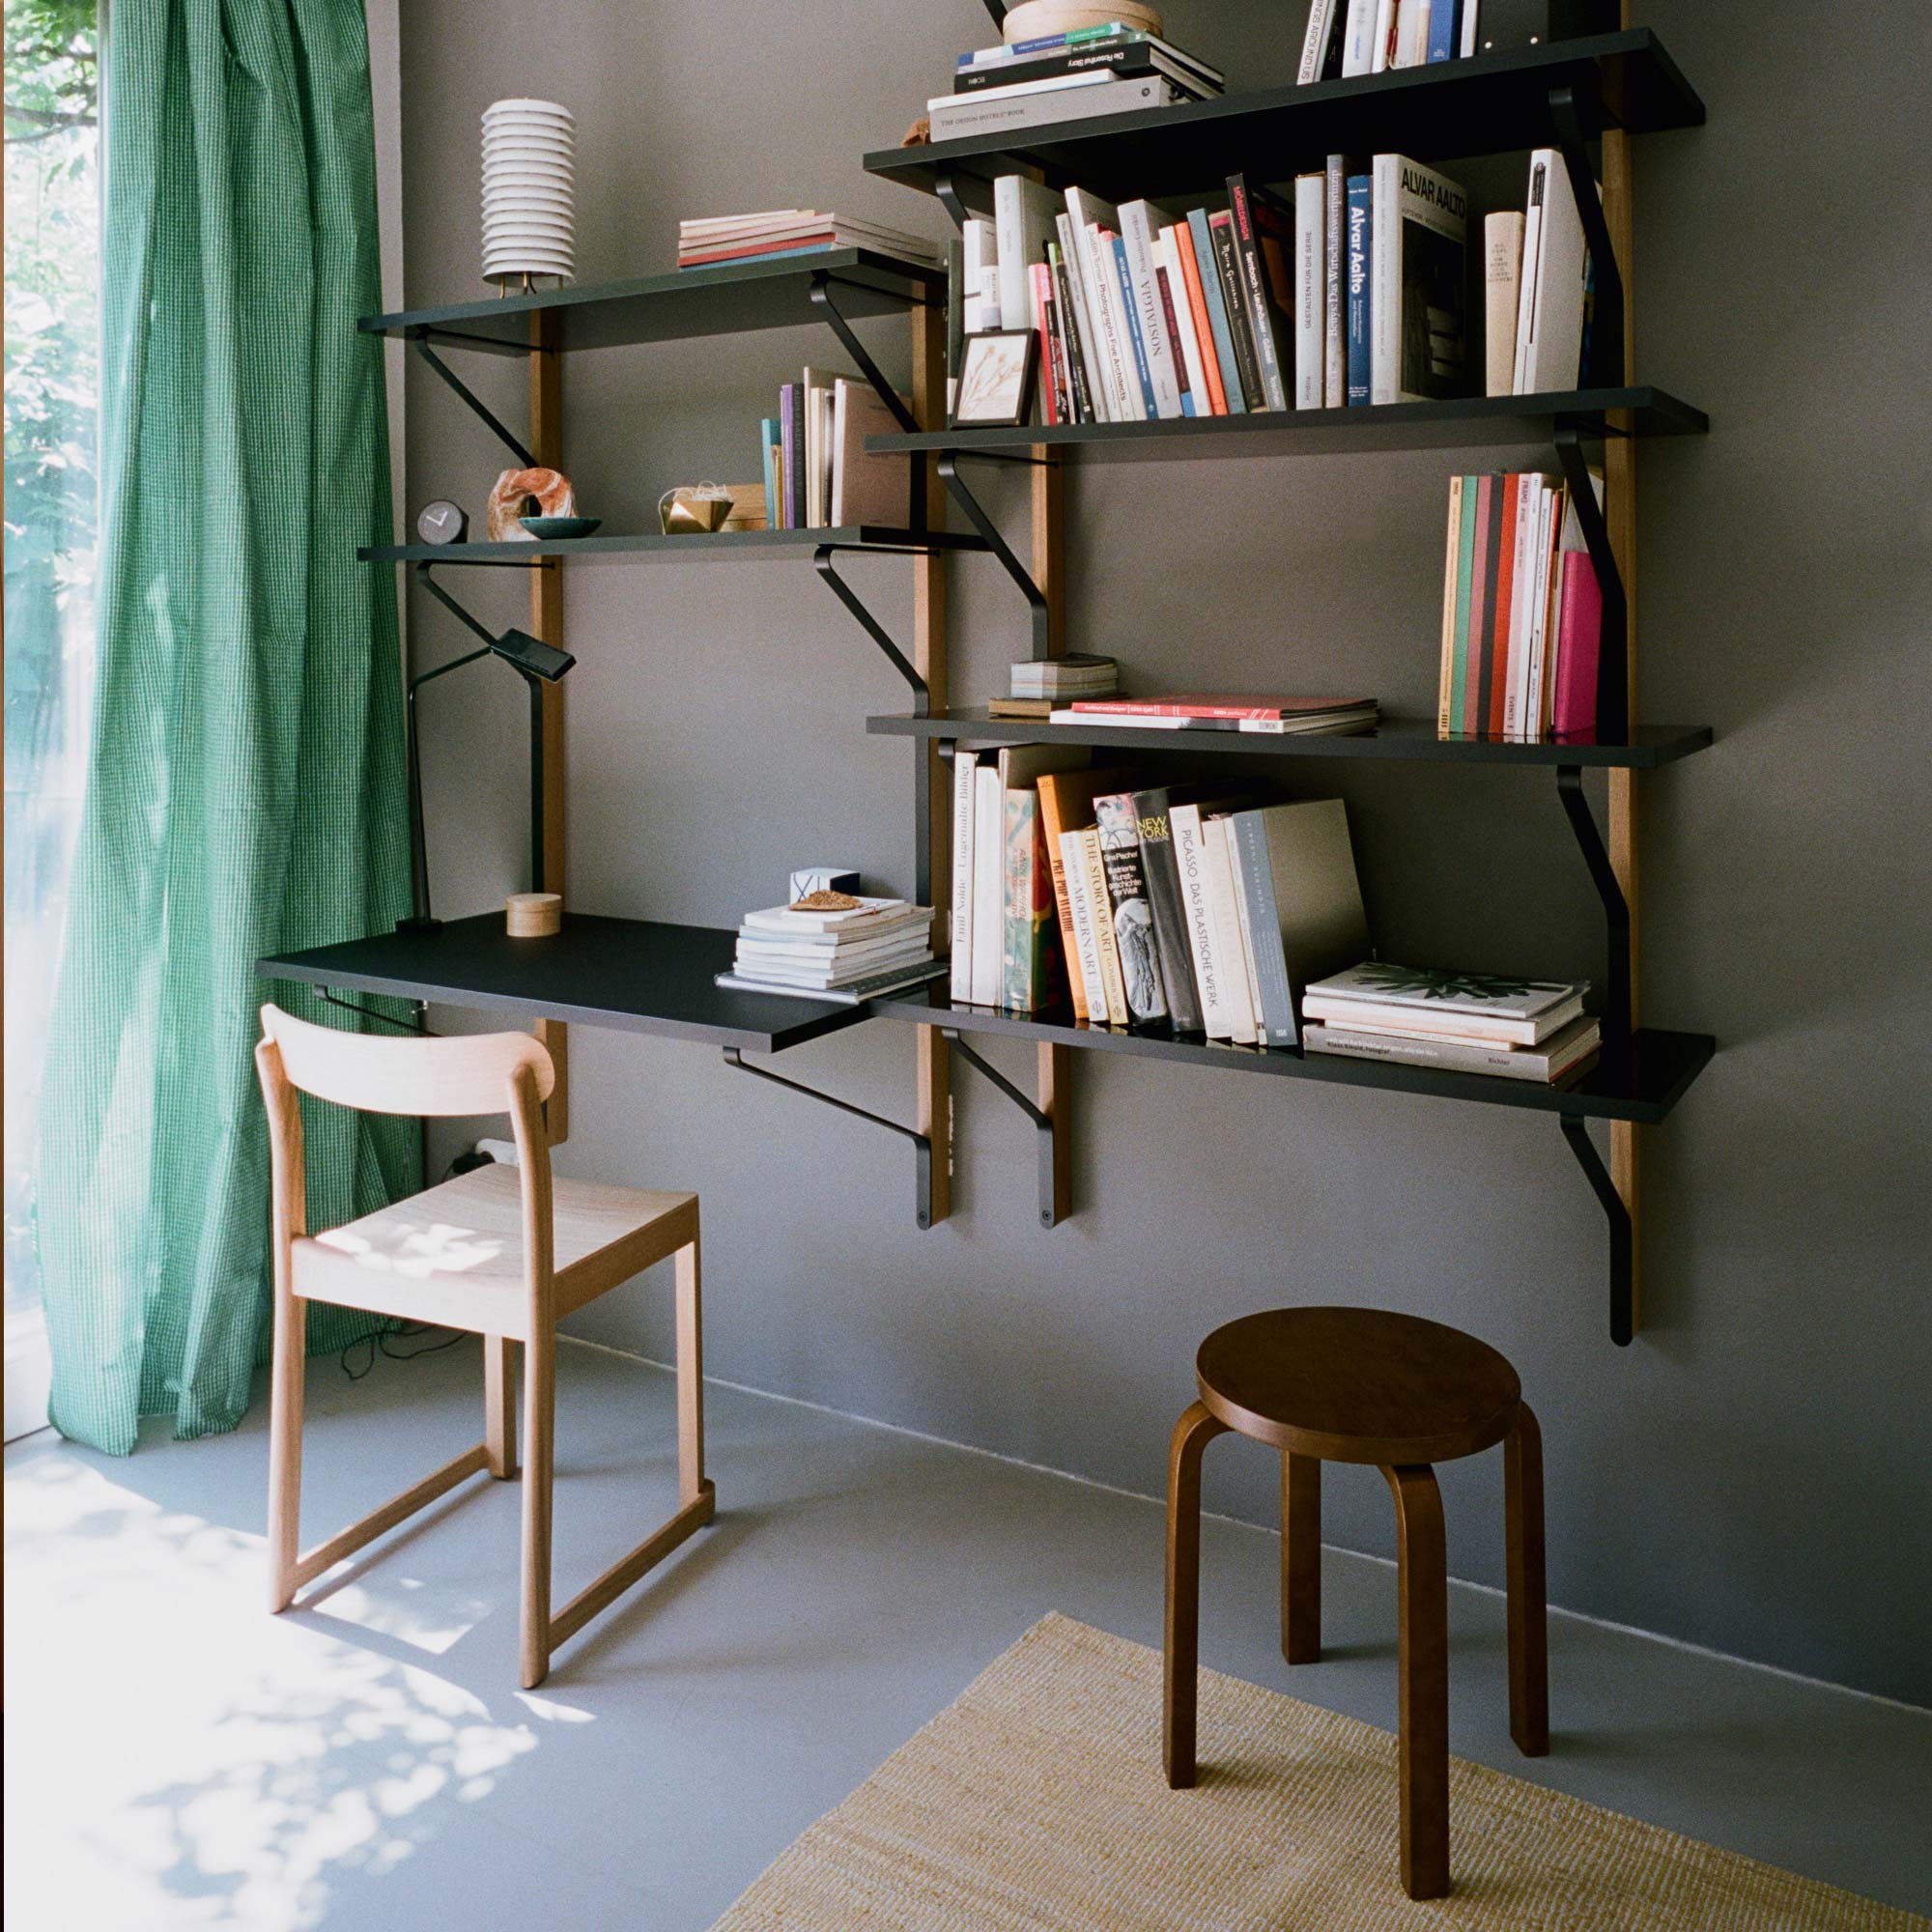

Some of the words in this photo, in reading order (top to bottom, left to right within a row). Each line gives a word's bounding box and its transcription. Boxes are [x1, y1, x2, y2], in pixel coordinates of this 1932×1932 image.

[1084, 53, 1112, 66] Rosenthal
[1113, 51, 1124, 62] Die
[1305, 25, 1320, 66] AROUND
[1066, 56, 1084, 68] Story
[1301, 66, 1311, 79] US
[1402, 167, 1435, 204] ALVAR
[1435, 185, 1465, 220] AALTO
[1350, 207, 1365, 249] Alvar
[1350, 252, 1365, 294] Aalto
[1233, 185, 1250, 240] MÖBELDESIGN
[1245, 251, 1259, 288] Sembach
[1268, 375, 1281, 407] Taschen
[1328, 282, 1341, 302] Das
[1098, 284, 1115, 338] Photographs
[1140, 280, 1161, 355] NOSTALGIA
[1109, 338, 1119, 357] Five
[1112, 357, 1126, 400] Architects
[1506, 696, 1515, 721] EVENTS
[1136, 816, 1166, 829] NEW
[1138, 826, 1169, 838] YORK
[1084, 834, 1098, 864] THE
[1179, 828, 1199, 878] PICASSO
[956, 879, 965, 910] Nolde
[1018, 878, 1027, 921] WARHOL
[1055, 879, 1068, 897] POP
[1089, 865, 1106, 905] STORY
[1189, 882, 1202, 905] DAS
[955, 915, 965, 942] Emil
[1096, 906, 1109, 925] OF
[1072, 886, 1093, 948] MODERN
[1083, 950, 1097, 977] ART
[1099, 929, 1114, 952] ART
[1192, 907, 1212, 972] PLASTISCHE
[1203, 973, 1218, 1008] WERK
